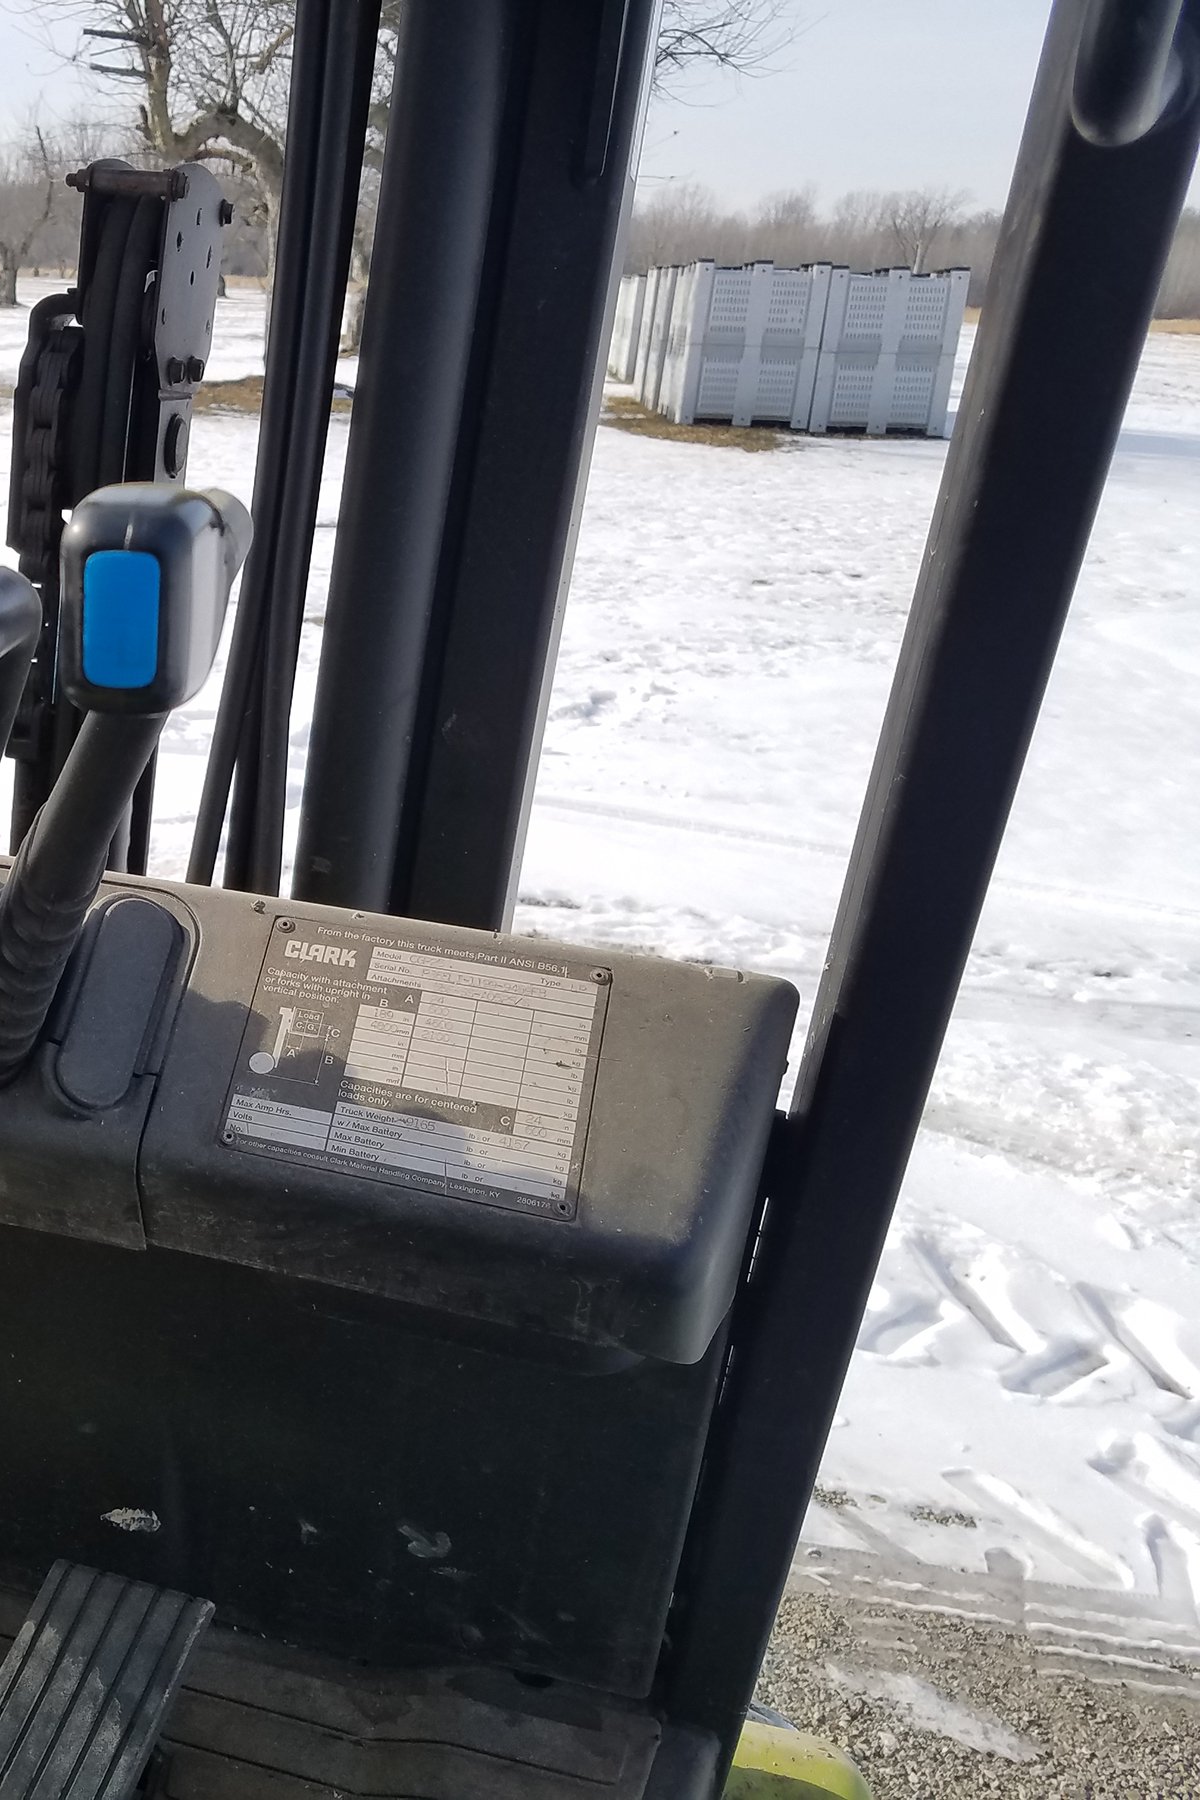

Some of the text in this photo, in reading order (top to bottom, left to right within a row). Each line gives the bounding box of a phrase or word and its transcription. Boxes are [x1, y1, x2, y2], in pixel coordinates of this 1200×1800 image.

[284, 940, 358, 968] CLARK
[318, 926, 342, 938] From
[344, 931, 360, 940] the
[361, 933, 395, 947] factory
[397, 940, 414, 950] this
[417, 942, 442, 954] truck
[476, 952, 498, 963] Part
[508, 958, 536, 969] ANSI
[537, 962, 565, 974] B56.1
[376, 950, 402, 961] Model
[374, 962, 397, 972] Serial
[266, 966, 388, 995] Capacity with attachment
[370, 974, 422, 988] Attachments
[540, 976, 561, 988] Type
[263, 984, 298, 996] vertical
[277, 977, 302, 988] forks
[303, 982, 324, 992] with
[325, 986, 360, 1001] upright
[361, 990, 371, 1000] in
[379, 998, 389, 1007] B
[404, 994, 414, 1004] A
[298, 1011, 321, 1020] Load
[330, 1028, 341, 1038] C
[286, 1048, 296, 1058] A
[324, 1055, 334, 1065] B
[337, 1088, 392, 1108] loads only.
[340, 1080, 478, 1114] Capacities are for centered
[236, 1098, 292, 1116] Max Amp Hrs.
[233, 1111, 254, 1122] Volts
[340, 1106, 364, 1118] Truck
[365, 1110, 395, 1124] Weight
[500, 1116, 511, 1126] C
[229, 1124, 244, 1133] No.
[352, 1122, 370, 1133] Max
[372, 1126, 403, 1140] Battery
[334, 1131, 385, 1149] Max Battery
[330, 1144, 380, 1161] Min Battery
[249, 1140, 267, 1150] other
[267, 1144, 302, 1157] capacities
[302, 1151, 330, 1163] consult
[330, 1156, 348, 1167] Clark
[349, 1160, 378, 1173] Material
[379, 1167, 410, 1181] Handling
[489, 1190, 501, 1199] KY
